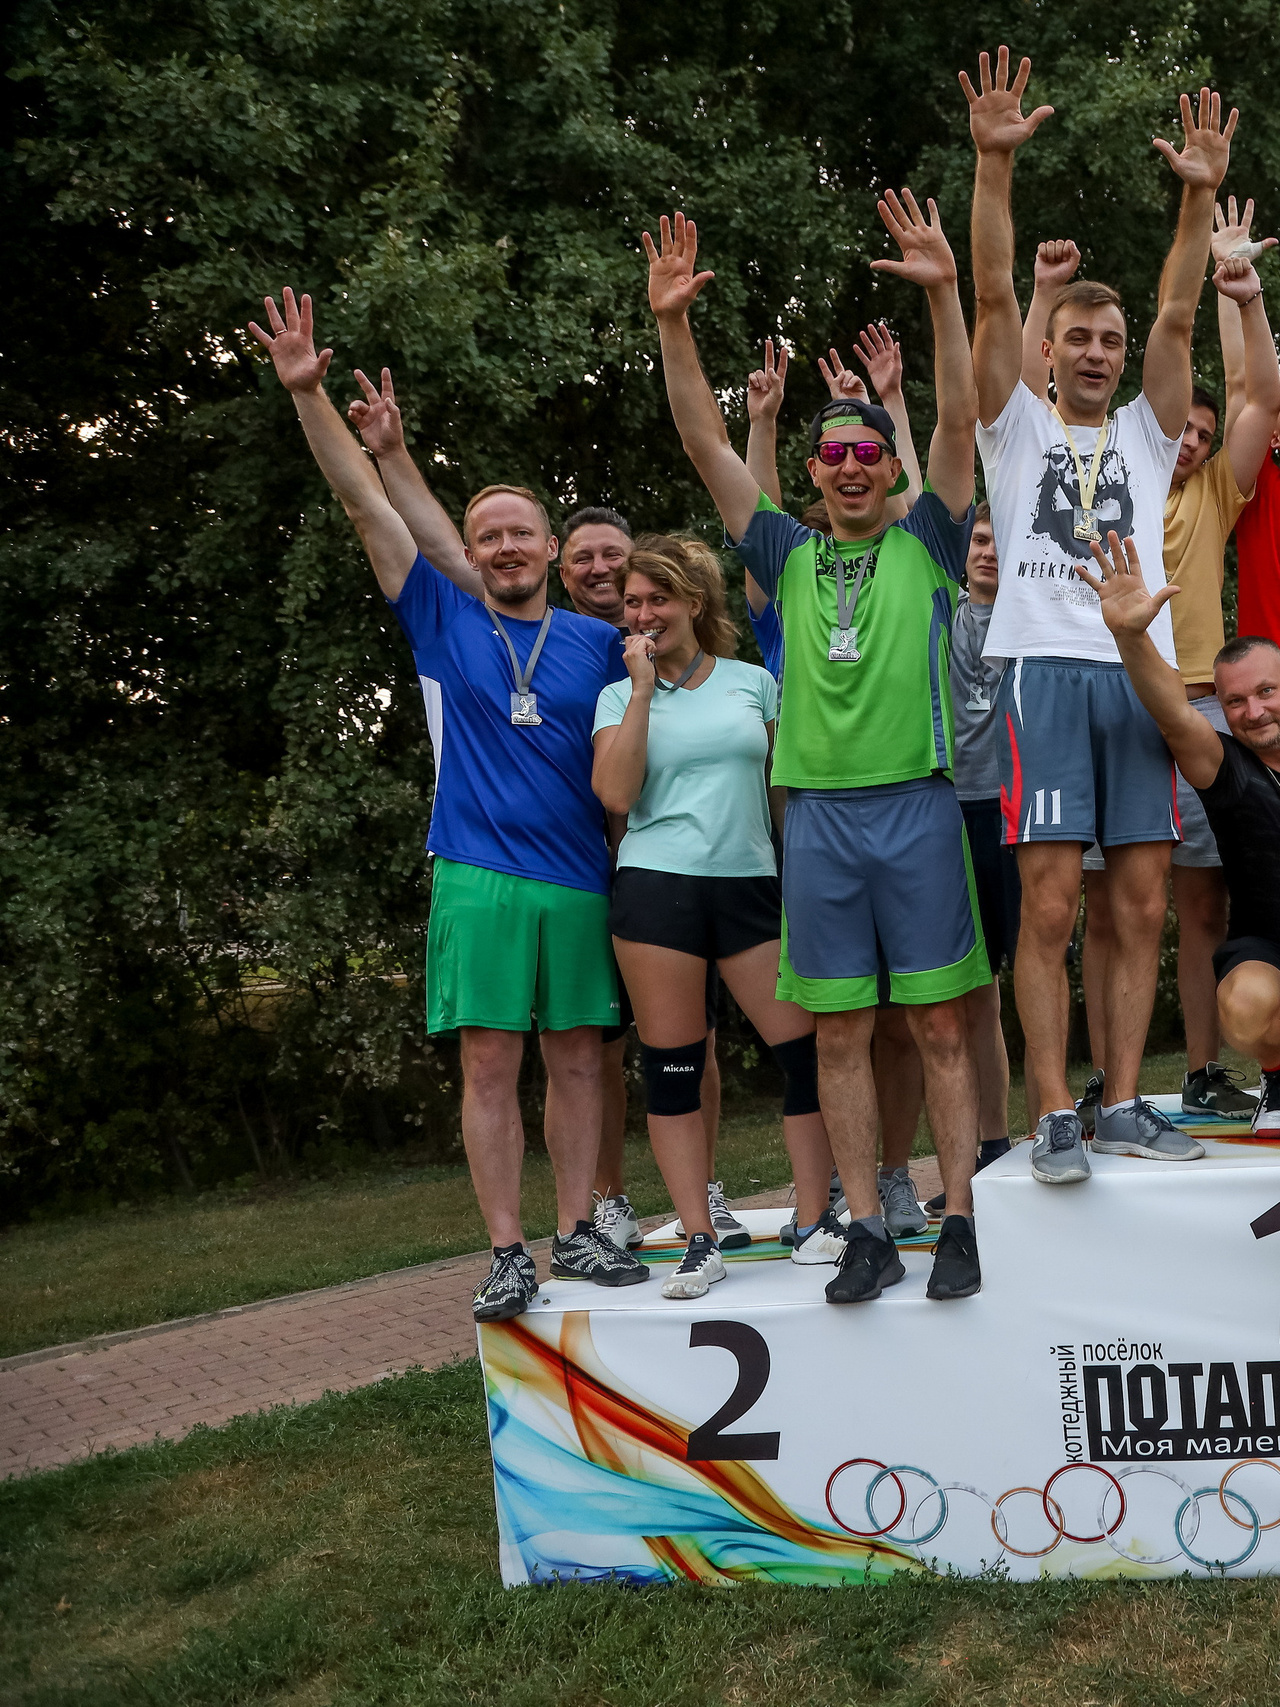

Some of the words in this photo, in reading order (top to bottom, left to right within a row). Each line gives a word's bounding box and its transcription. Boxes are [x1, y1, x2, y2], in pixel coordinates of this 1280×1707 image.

[1034, 788, 1061, 825] 11
[1083, 1337, 1164, 1362] посёлок
[686, 1319, 781, 1461] 2
[1049, 1344, 1085, 1463] коттеджный
[1101, 1435, 1173, 1456] Моя
